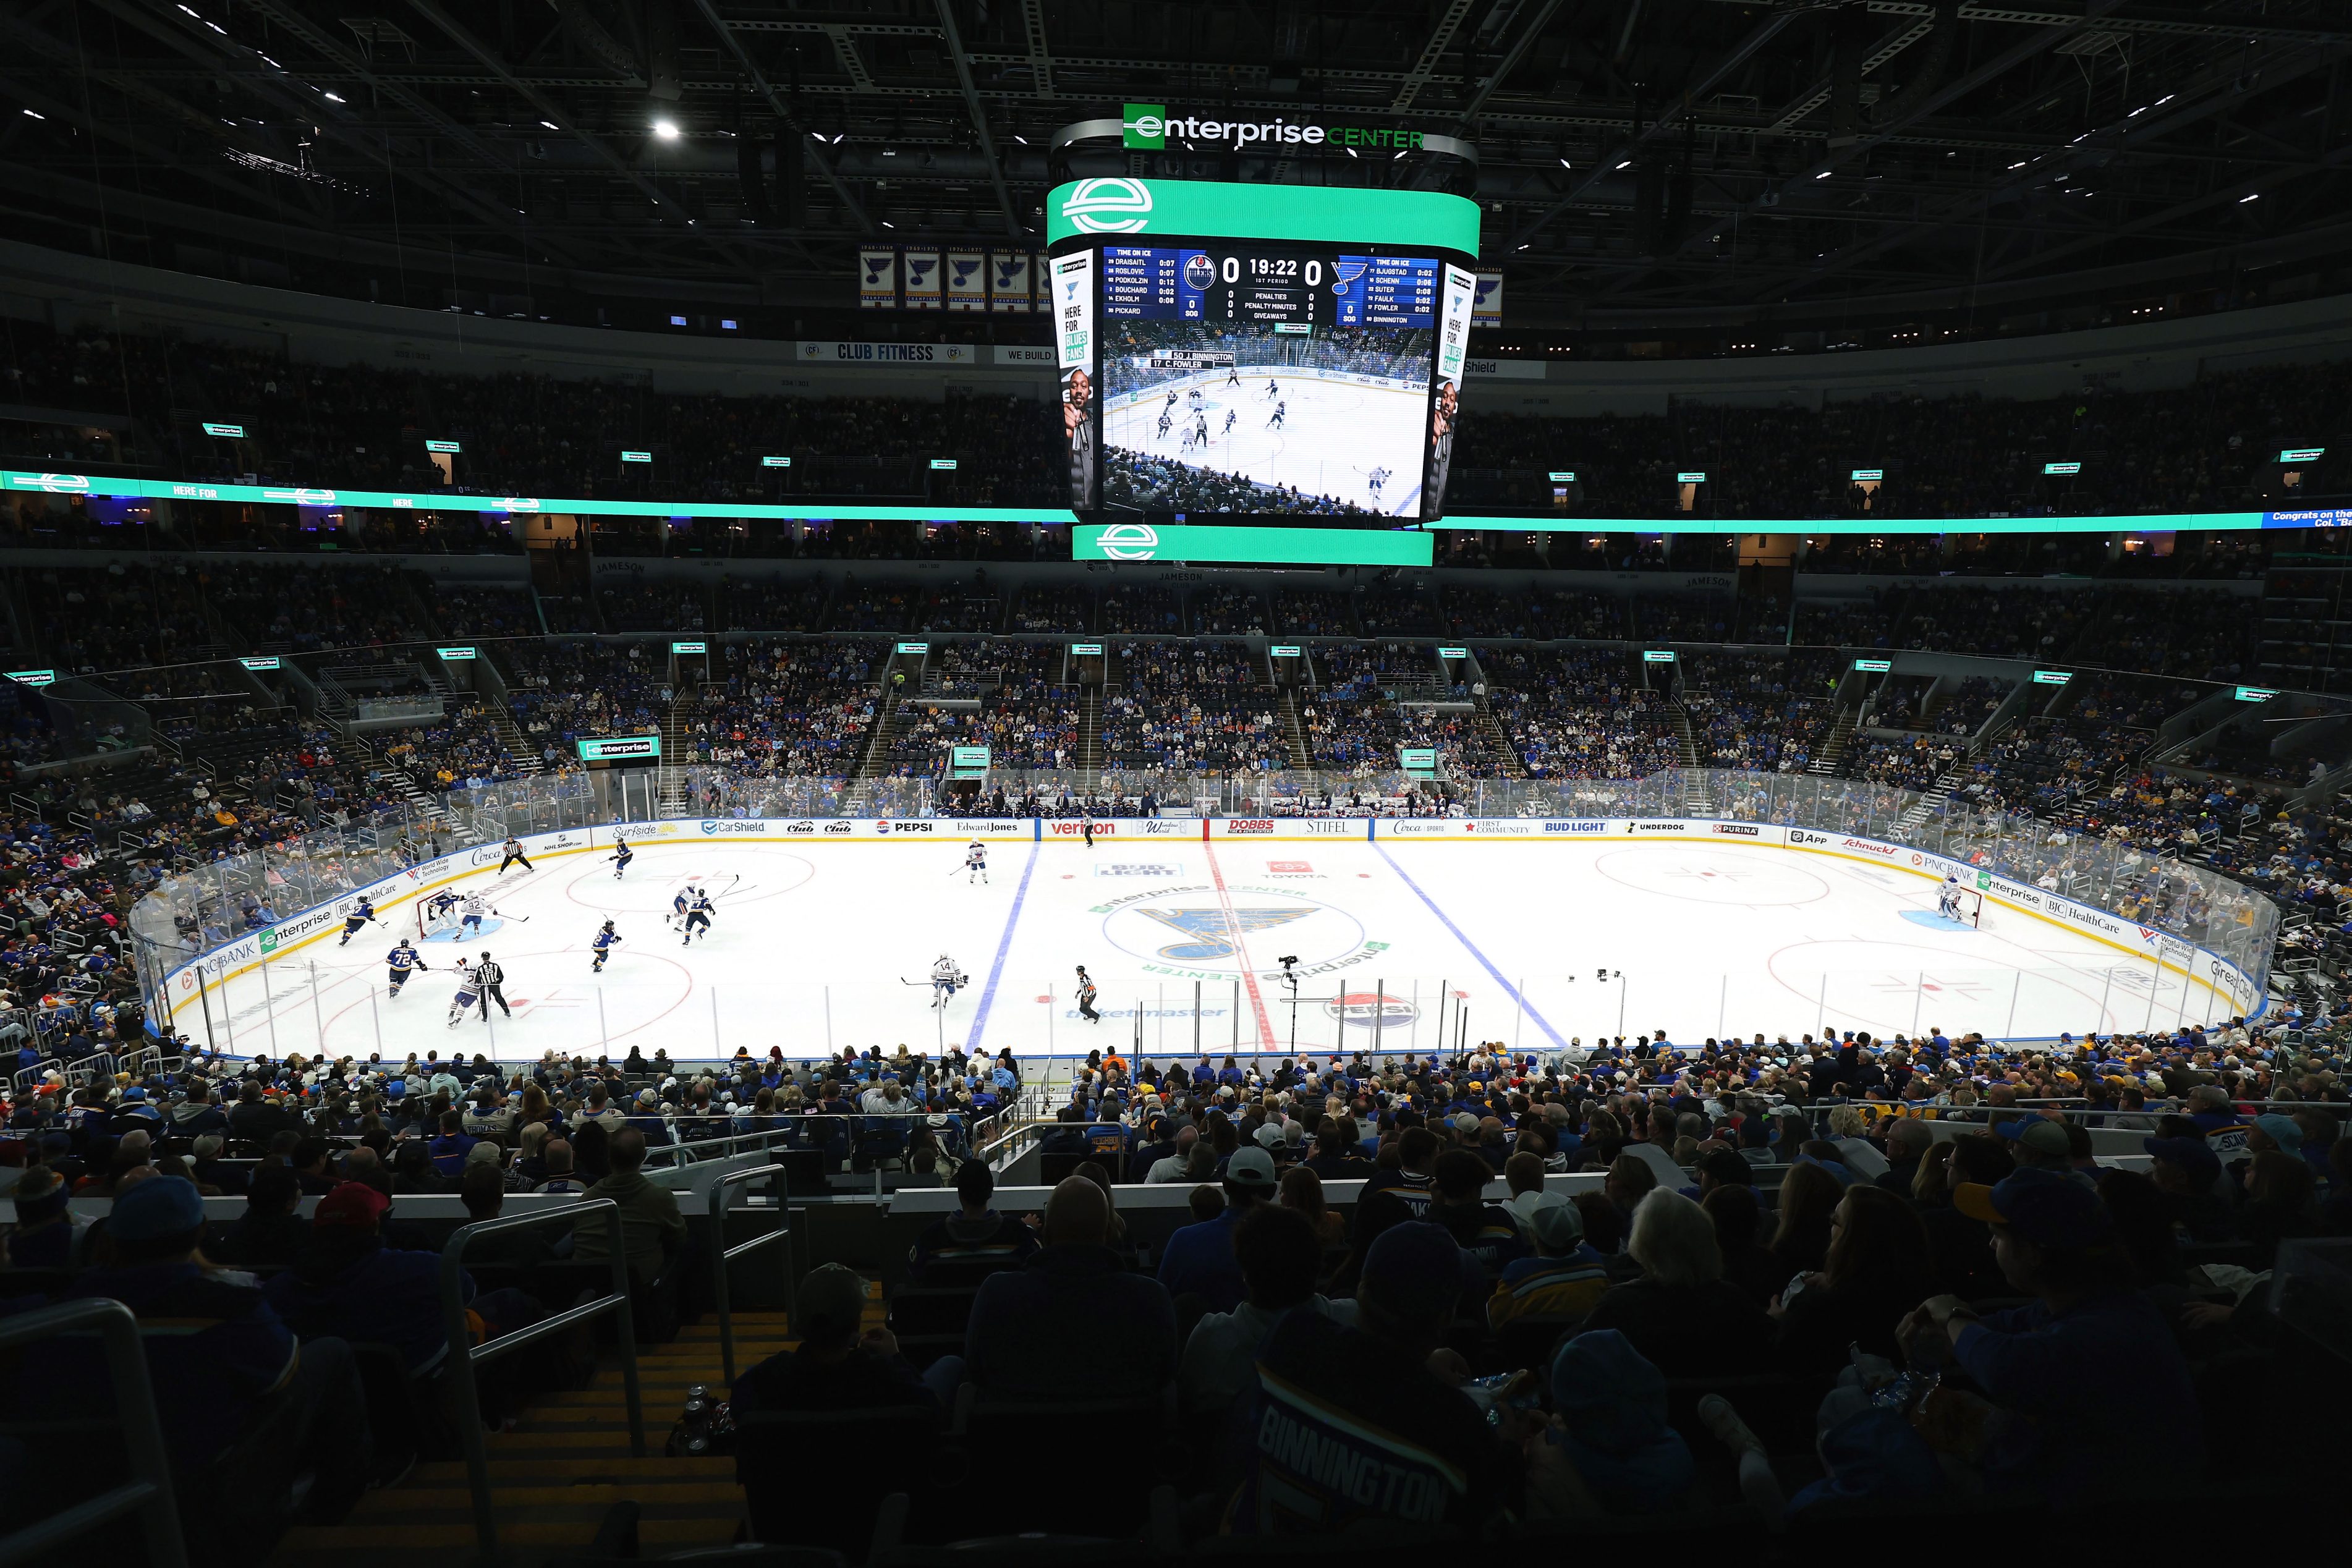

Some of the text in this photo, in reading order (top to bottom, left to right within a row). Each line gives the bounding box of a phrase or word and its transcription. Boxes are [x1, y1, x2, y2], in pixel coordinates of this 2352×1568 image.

[1123, 116, 1424, 148] enterprise CENTER
[1057, 259, 1087, 274] enterprise
[1223, 257, 1322, 286] 0 19:22 0
[1450, 274, 1471, 289] enterprise
[1309, 293, 1314, 301] 0
[1189, 300, 1195, 308] 0
[1308, 303, 1314, 311] 0
[1347, 305, 1353, 314] 0
[1065, 305, 1081, 319] HERE
[1228, 310, 1233, 318] 0
[1066, 320, 1078, 333] FOR
[1448, 318, 1461, 333] HERE
[1066, 331, 1087, 347] BLUES
[1447, 331, 1457, 344] FOR
[838, 344, 933, 362] CLUB FITNESS
[1008, 351, 1051, 360] WE BUILD
[1066, 346, 1084, 362] FANS
[1445, 345, 1461, 360] BLUES
[1444, 359, 1457, 372] FANS
[173, 486, 218, 499] HERE FOR
[393, 499, 413, 507] HERE
[2273, 512, 2318, 521] Congrats
[2335, 509, 2352, 518] the
[2315, 519, 2335, 527] Col.
[596, 562, 645, 574] JAMESON
[1159, 573, 1202, 581] JAMESON
[1686, 577, 1731, 588] JAMESON
[588, 744, 650, 754] enterprise
[718, 822, 765, 833] CarShield
[788, 825, 814, 833] Club
[825, 825, 851, 833] Club
[895, 823, 932, 831] PEPSI
[957, 822, 1017, 831] Edward Jones
[1229, 820, 1274, 829] DOBBS
[1307, 820, 1349, 833] STIFEL
[1393, 820, 1422, 834] Circa
[1545, 823, 1606, 832] BUD LIGHT
[1723, 825, 1757, 835] PURINA
[613, 824, 656, 839] Surfside
[1841, 839, 1899, 855] Schnucks
[472, 848, 502, 866] Circa
[422, 858, 449, 871] World Wide
[1925, 857, 1973, 882] PNC BANK
[422, 865, 449, 878] Technology
[1228, 885, 1307, 897] CENTER
[1977, 875, 2040, 905] enterprise
[339, 900, 354, 915] BJC
[2048, 900, 2120, 934] BJC HealthCare
[260, 911, 331, 947] enterprise
[2160, 934, 2180, 949] World
[221, 941, 255, 968] BANK
[396, 954, 411, 965] 72
[940, 962, 950, 971] 14
[1142, 964, 1241, 980] CENTER
[2210, 960, 2237, 988] Great
[1257, 1404, 1448, 1522] BINNINGTON
